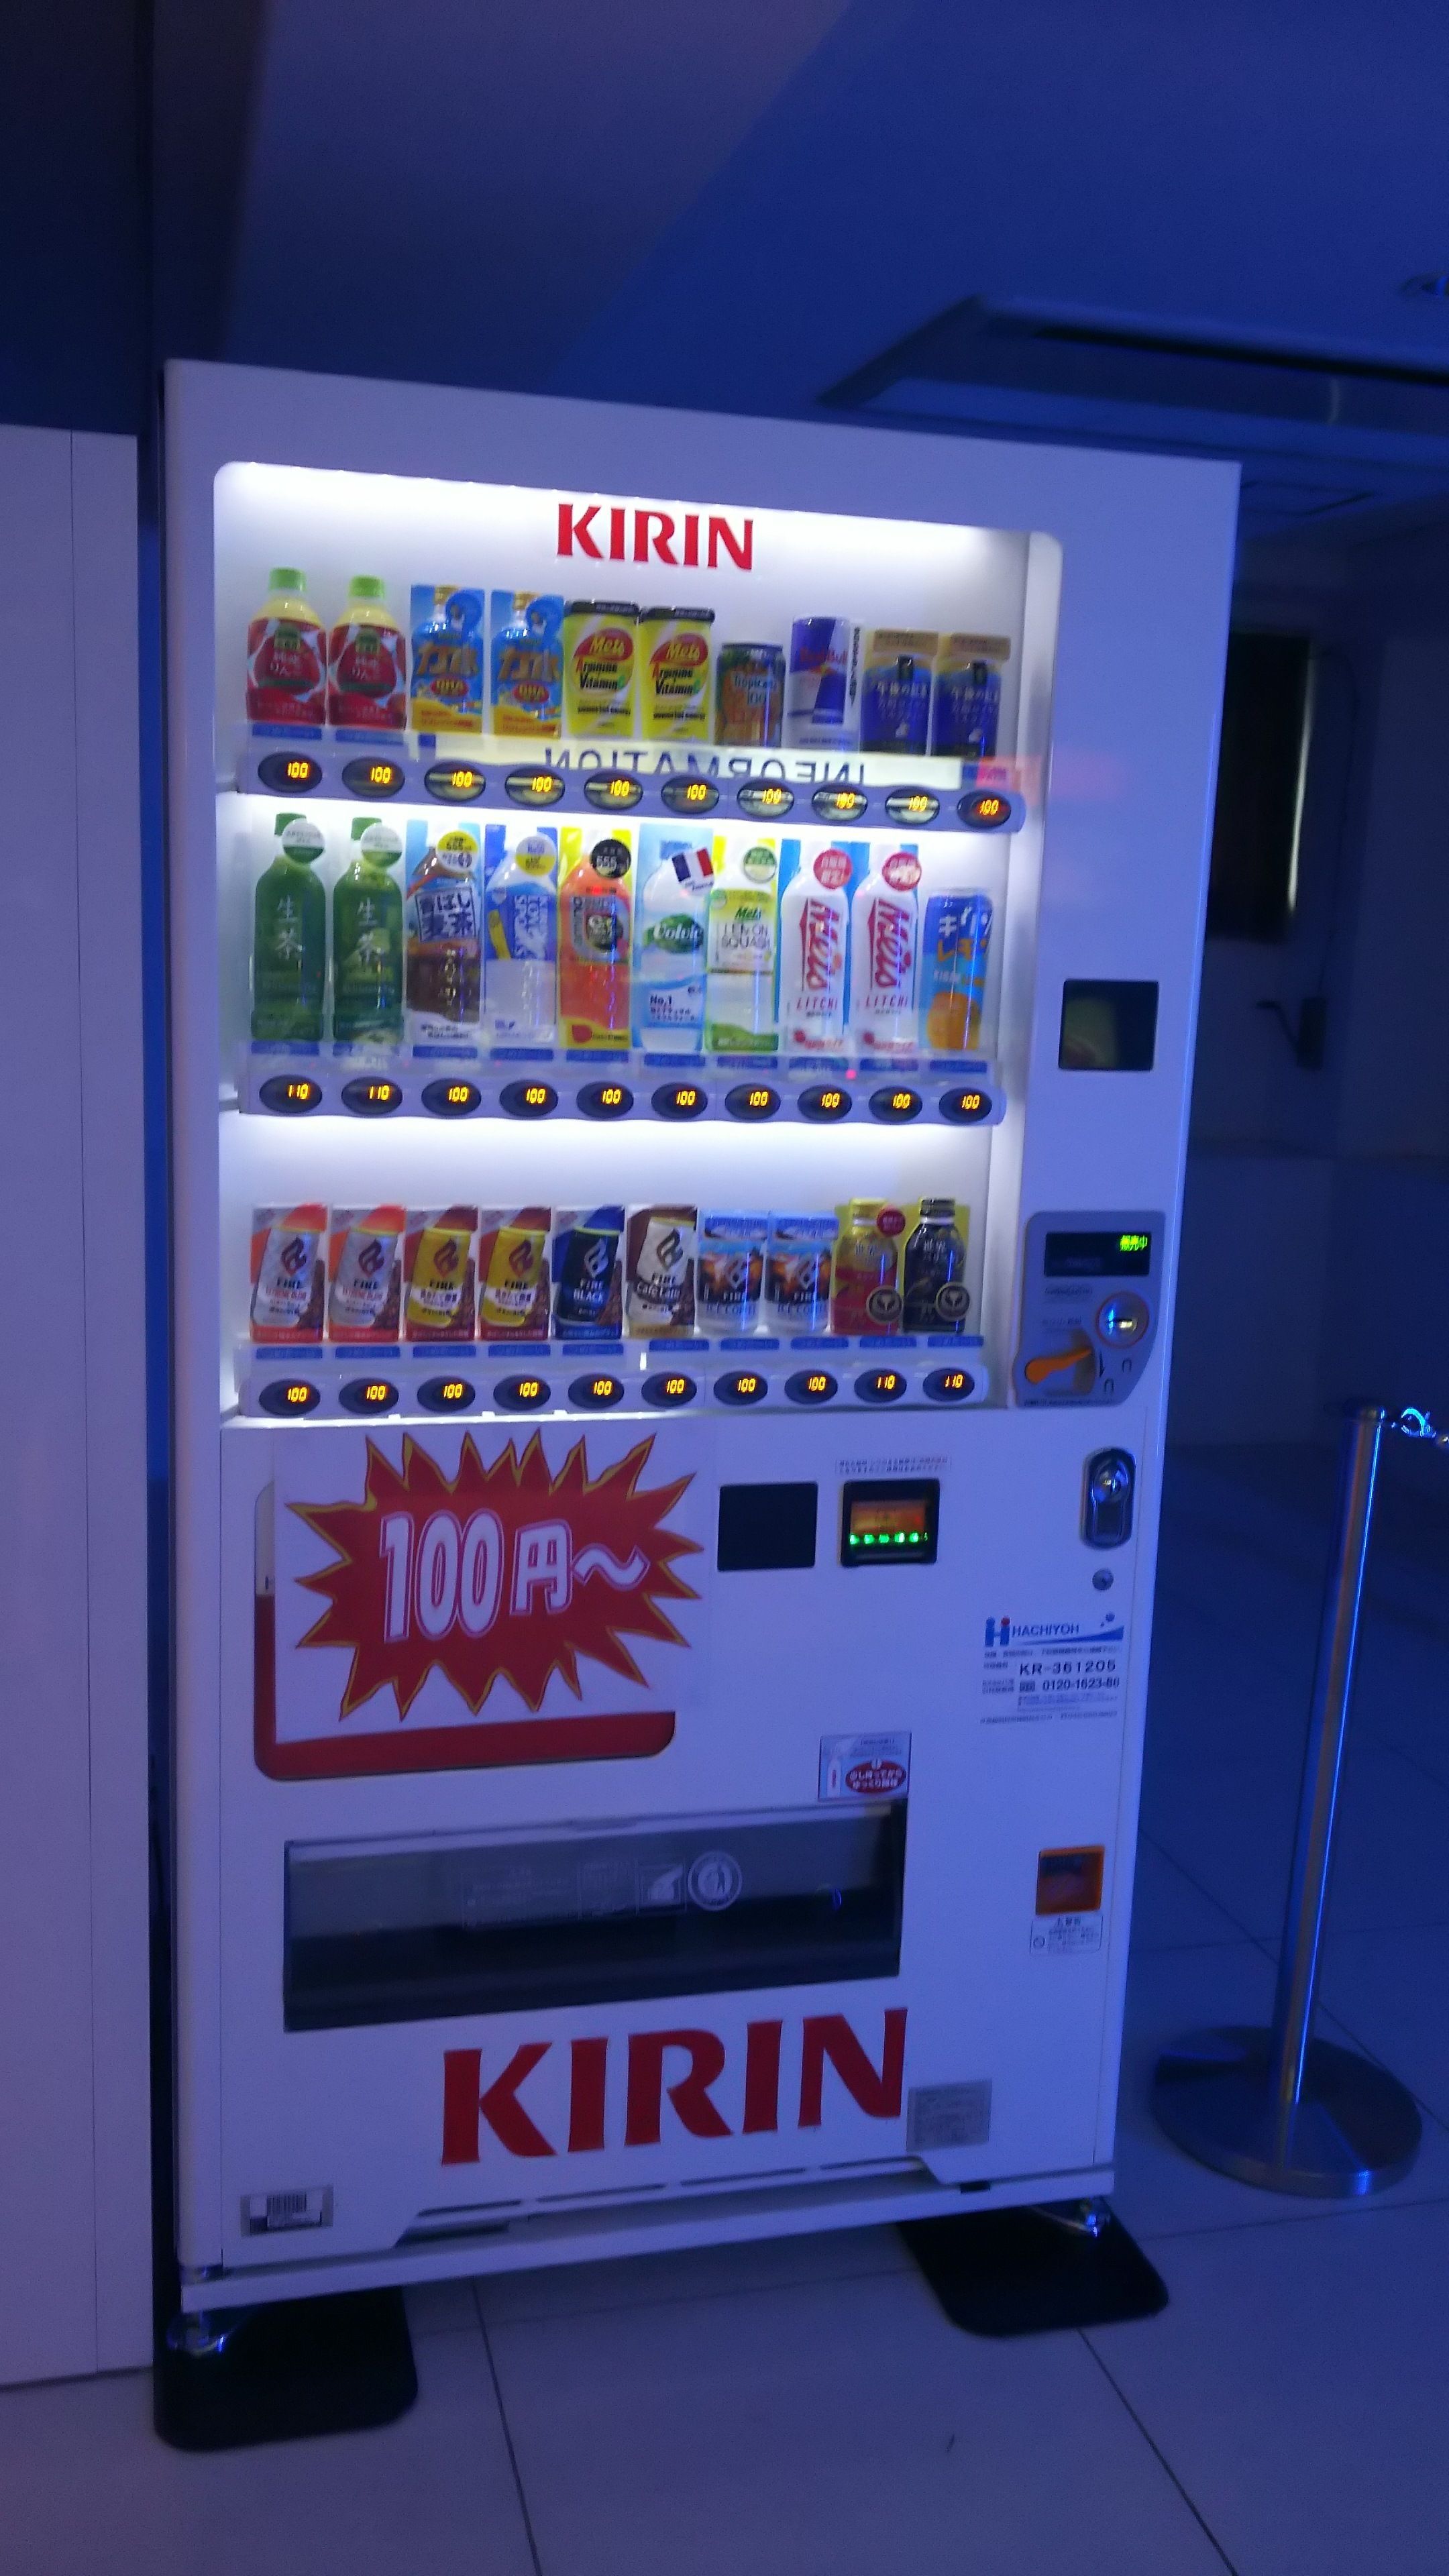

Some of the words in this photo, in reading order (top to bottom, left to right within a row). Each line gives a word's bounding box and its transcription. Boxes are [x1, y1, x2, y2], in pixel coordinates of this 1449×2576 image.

[557, 504, 754, 572] KIRIN
[288, 763, 308, 778] 100
[372, 767, 390, 784] 100
[452, 771, 474, 788] 100
[532, 776, 553, 792] 100
[610, 781, 631, 796] 100
[688, 784, 706, 800] 100
[980, 800, 999, 815] 100
[288, 1084, 309, 1099] 110
[370, 1085, 389, 1101] 110
[448, 1087, 468, 1102] 100
[527, 1089, 545, 1104] 100
[602, 1089, 621, 1104] 100
[676, 1091, 696, 1106] 100
[750, 1091, 769, 1106] 100
[822, 1093, 840, 1108] 100
[893, 1093, 911, 1108] 100
[962, 1095, 980, 1110] 100
[594, 1381, 612, 1395] 100
[667, 1379, 685, 1393] 100
[739, 1378, 756, 1392] 100
[808, 1377, 826, 1391] 100
[877, 1376, 895, 1390] 110
[945, 1374, 963, 1389] 110
[288, 1387, 307, 1403] 100
[366, 1385, 386, 1400] 100
[443, 1383, 463, 1398] 100
[519, 1382, 538, 1397] 100
[1011, 1623, 1079, 1638] HACHIYOH
[441, 2007, 908, 2166] KIRIN
